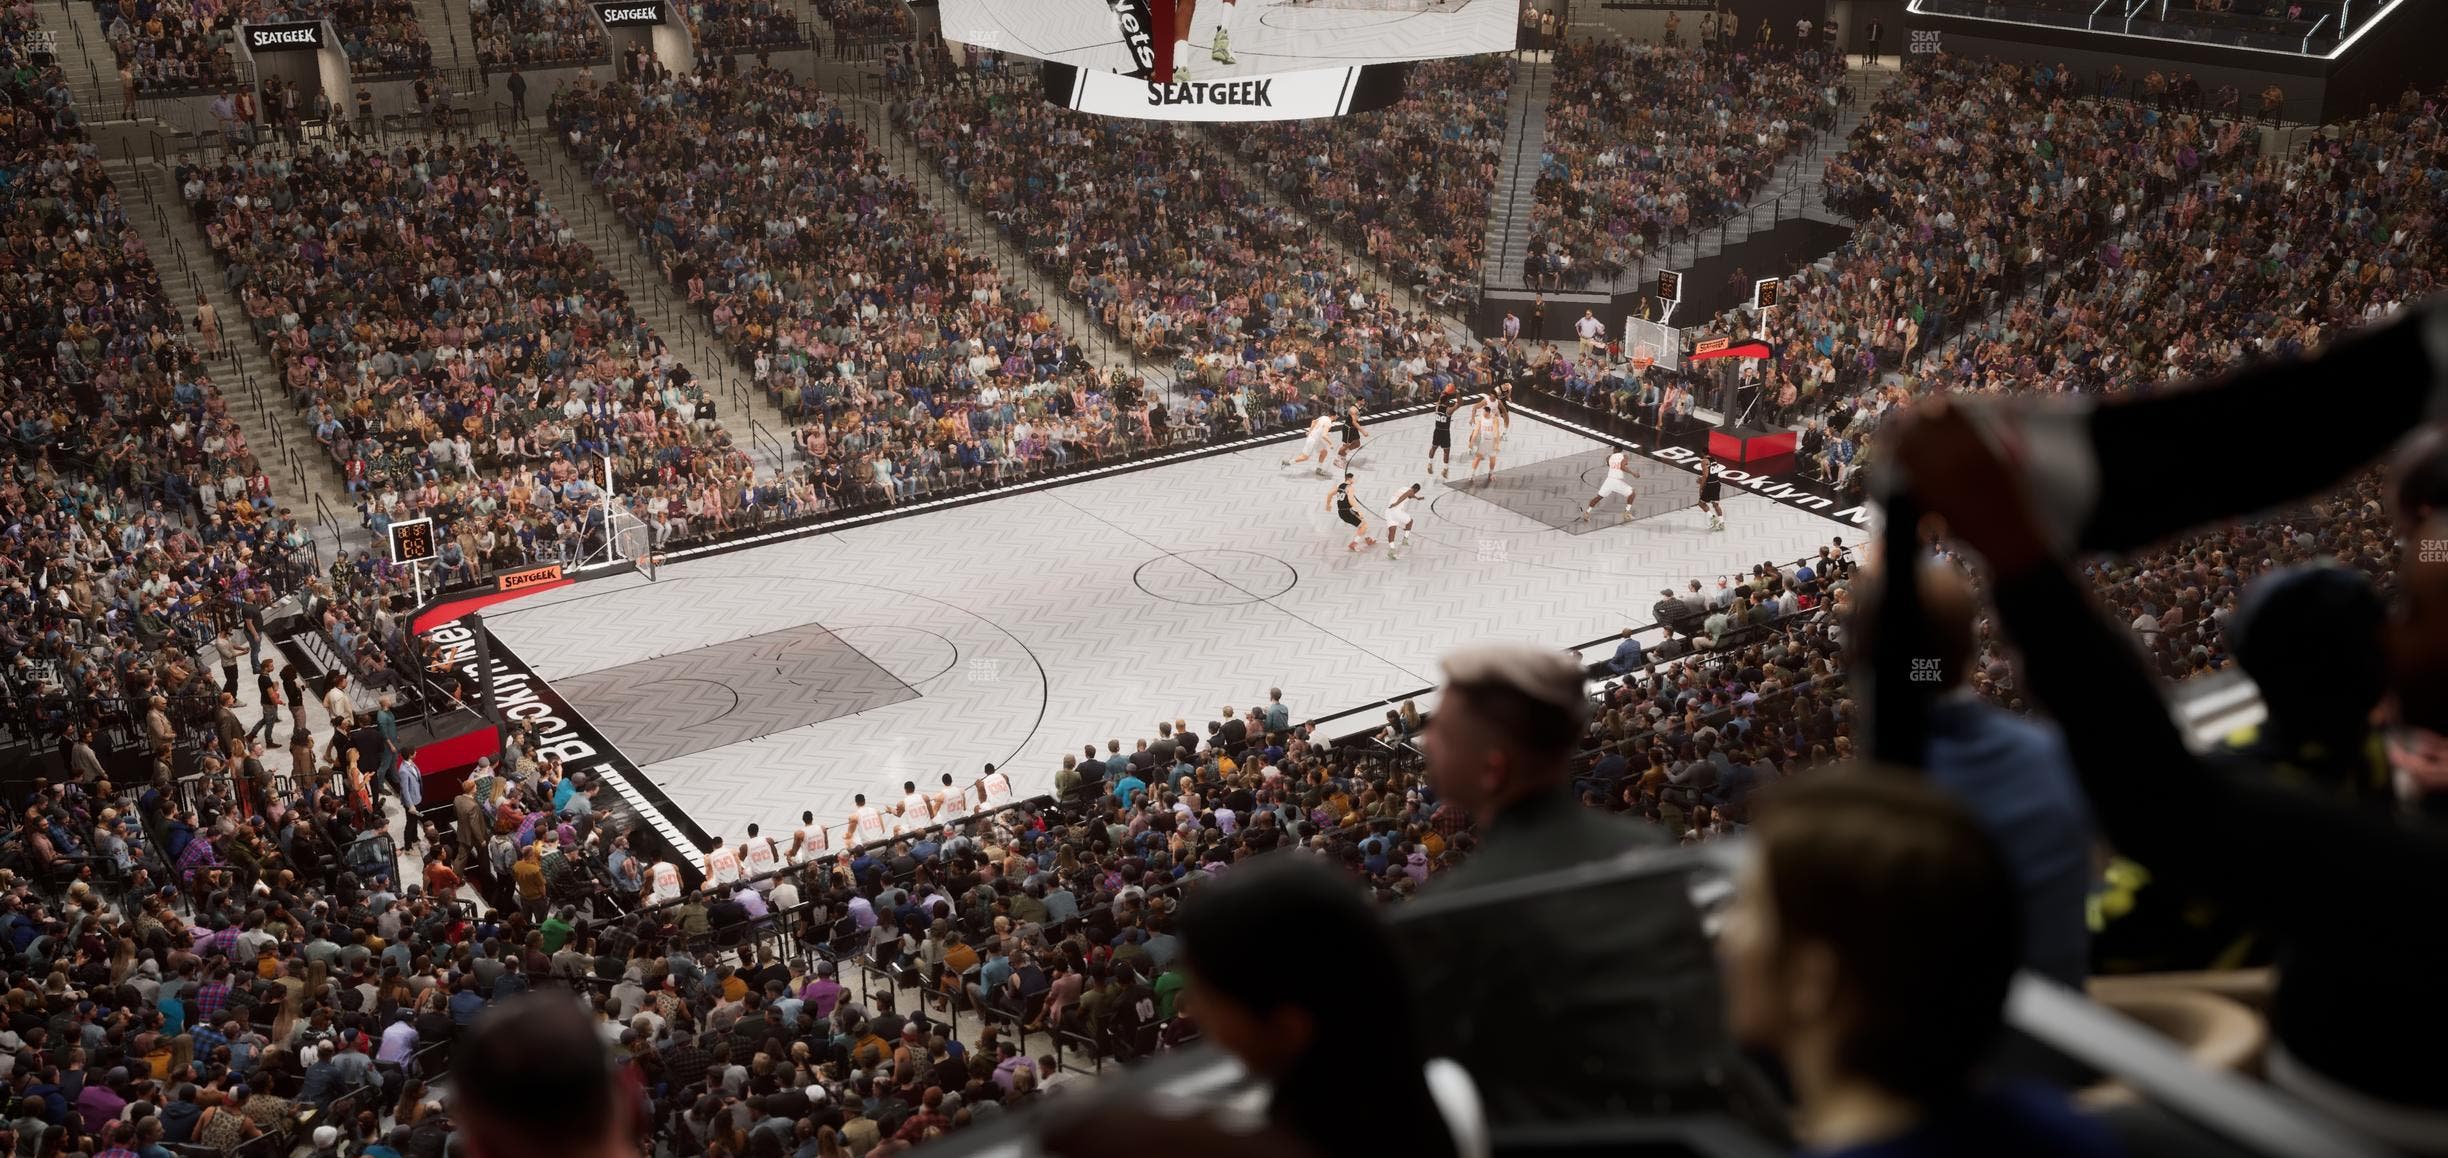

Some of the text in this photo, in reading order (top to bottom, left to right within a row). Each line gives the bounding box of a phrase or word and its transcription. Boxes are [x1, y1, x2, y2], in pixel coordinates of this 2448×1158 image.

[604, 6, 657, 22] SEATGEEK
[253, 28, 317, 46] SEATGEEK
[1148, 78, 1272, 107] SEATGEEK
[505, 568, 556, 588] SEATGEEK
